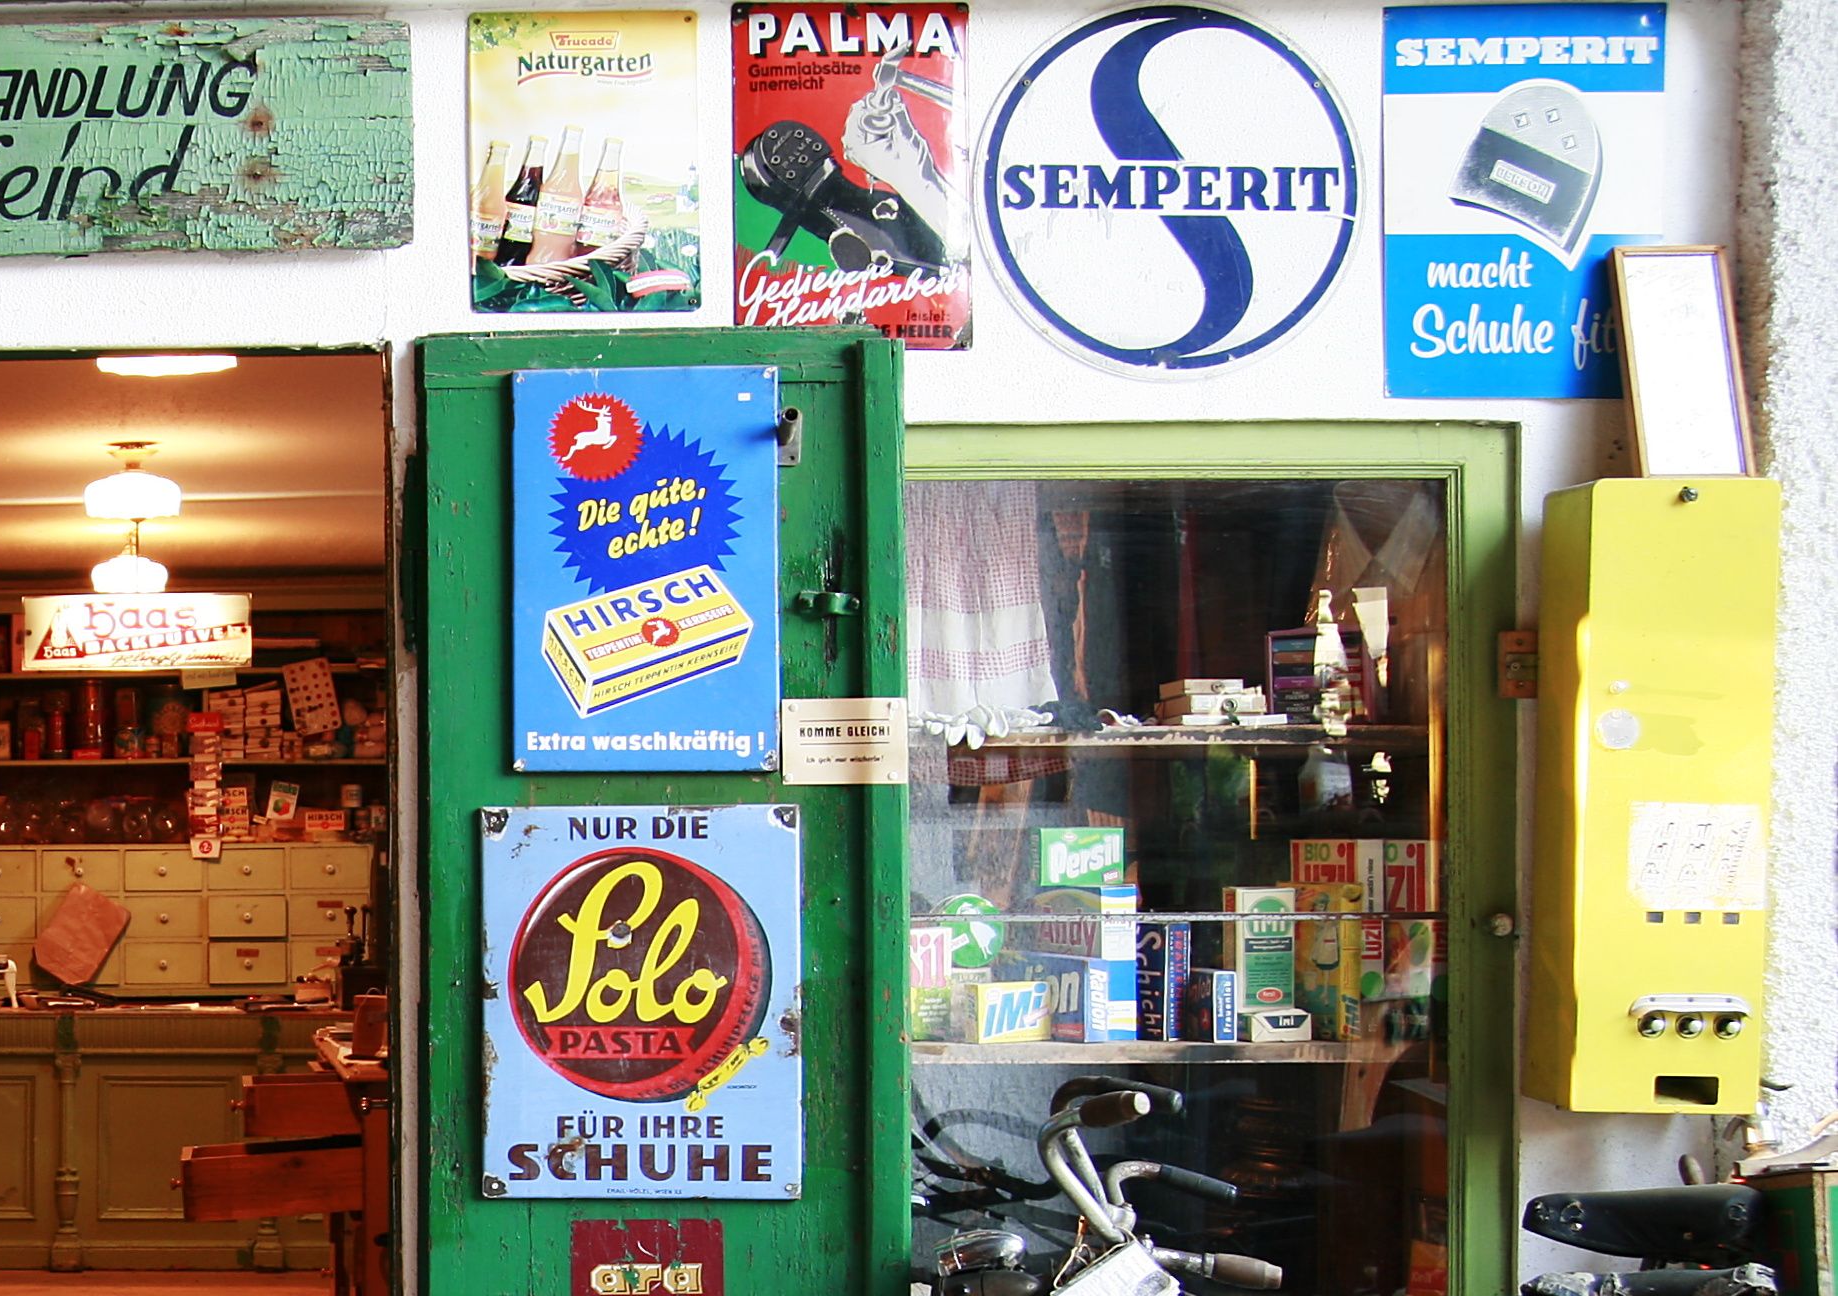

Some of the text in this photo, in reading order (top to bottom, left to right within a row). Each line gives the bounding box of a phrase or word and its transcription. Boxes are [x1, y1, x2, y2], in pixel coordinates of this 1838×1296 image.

[748, 12, 953, 57] PALMA
[1396, 35, 1658, 67] SEMPERIT
[518, 52, 651, 76] Naturgarten
[749, 76, 824, 92] unerreicht
[1004, 164, 1340, 212] SEMPERIT
[1427, 248, 1532, 288] macht
[744, 250, 894, 326] Gediegene
[768, 262, 966, 326] Handarbeit
[896, 324, 954, 338] HEILER
[1411, 306, 1554, 359] Schuhe
[578, 499, 620, 532] Die
[608, 508, 701, 559] echte!
[563, 573, 718, 636] HIRSCH
[594, 642, 739, 699] HIRSCH TERPENTIN KERNSEIFE
[527, 732, 586, 751] Extra
[592, 730, 751, 757] waschkräftig
[800, 725, 890, 737] KOMME GLEICH!
[307, 813, 343, 821] HIRSCH
[570, 816, 709, 841] NUR DIE
[1048, 833, 1121, 884] Persil
[1304, 843, 1331, 862] BIO
[523, 861, 728, 1023] Solo
[1089, 968, 1107, 1031] Radion
[561, 1030, 683, 1055] PASTA
[557, 1110, 724, 1139] FÜR IHRE
[508, 1144, 772, 1182] SCHUHE
[590, 1263, 703, 1295] ara
